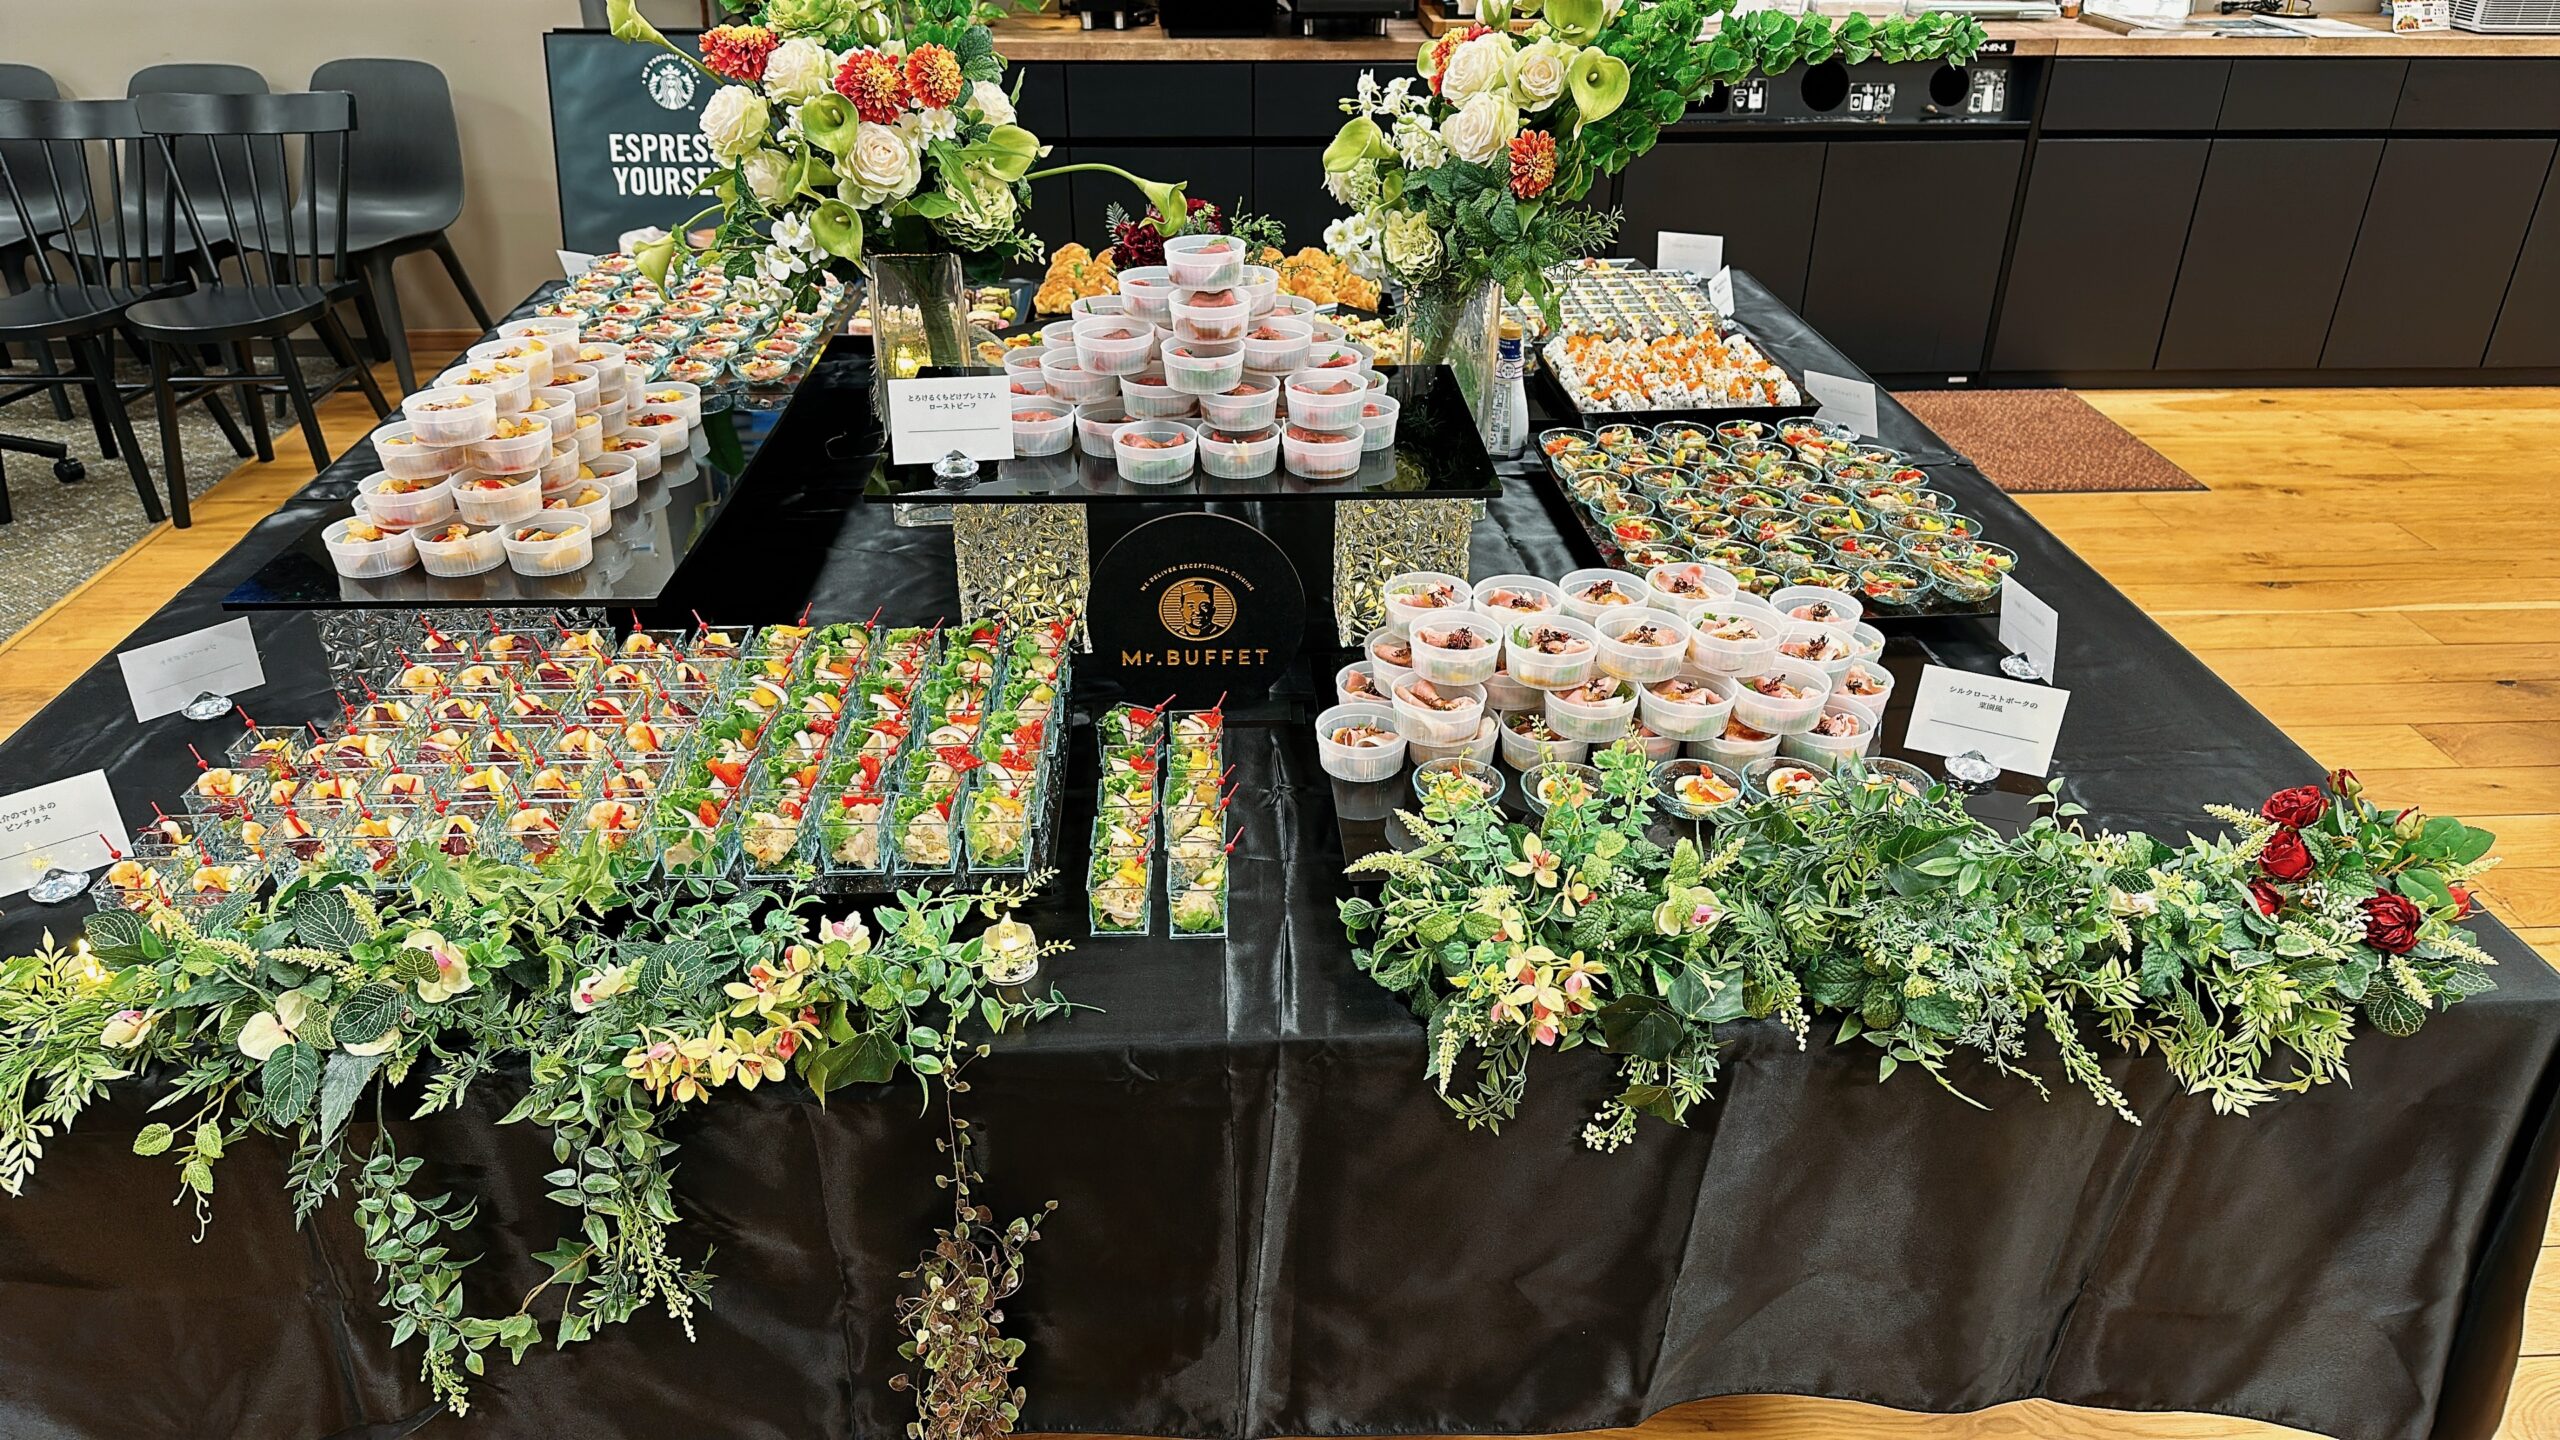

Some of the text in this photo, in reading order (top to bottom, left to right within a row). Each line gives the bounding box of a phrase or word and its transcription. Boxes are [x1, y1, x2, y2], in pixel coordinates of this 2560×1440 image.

[609, 133, 719, 163] ESPRES
[612, 166, 720, 196] YOURSE
[908, 392, 996, 402] とろけるくちどけプレミアム
[929, 402, 976, 410] ローストビーフ
[1150, 566, 1177, 583] DELIVER
[1179, 563, 1229, 574] EXCEPTIONAL
[1230, 570, 1255, 592] CUISINE
[1949, 685, 2038, 709] シルクローストポークの
